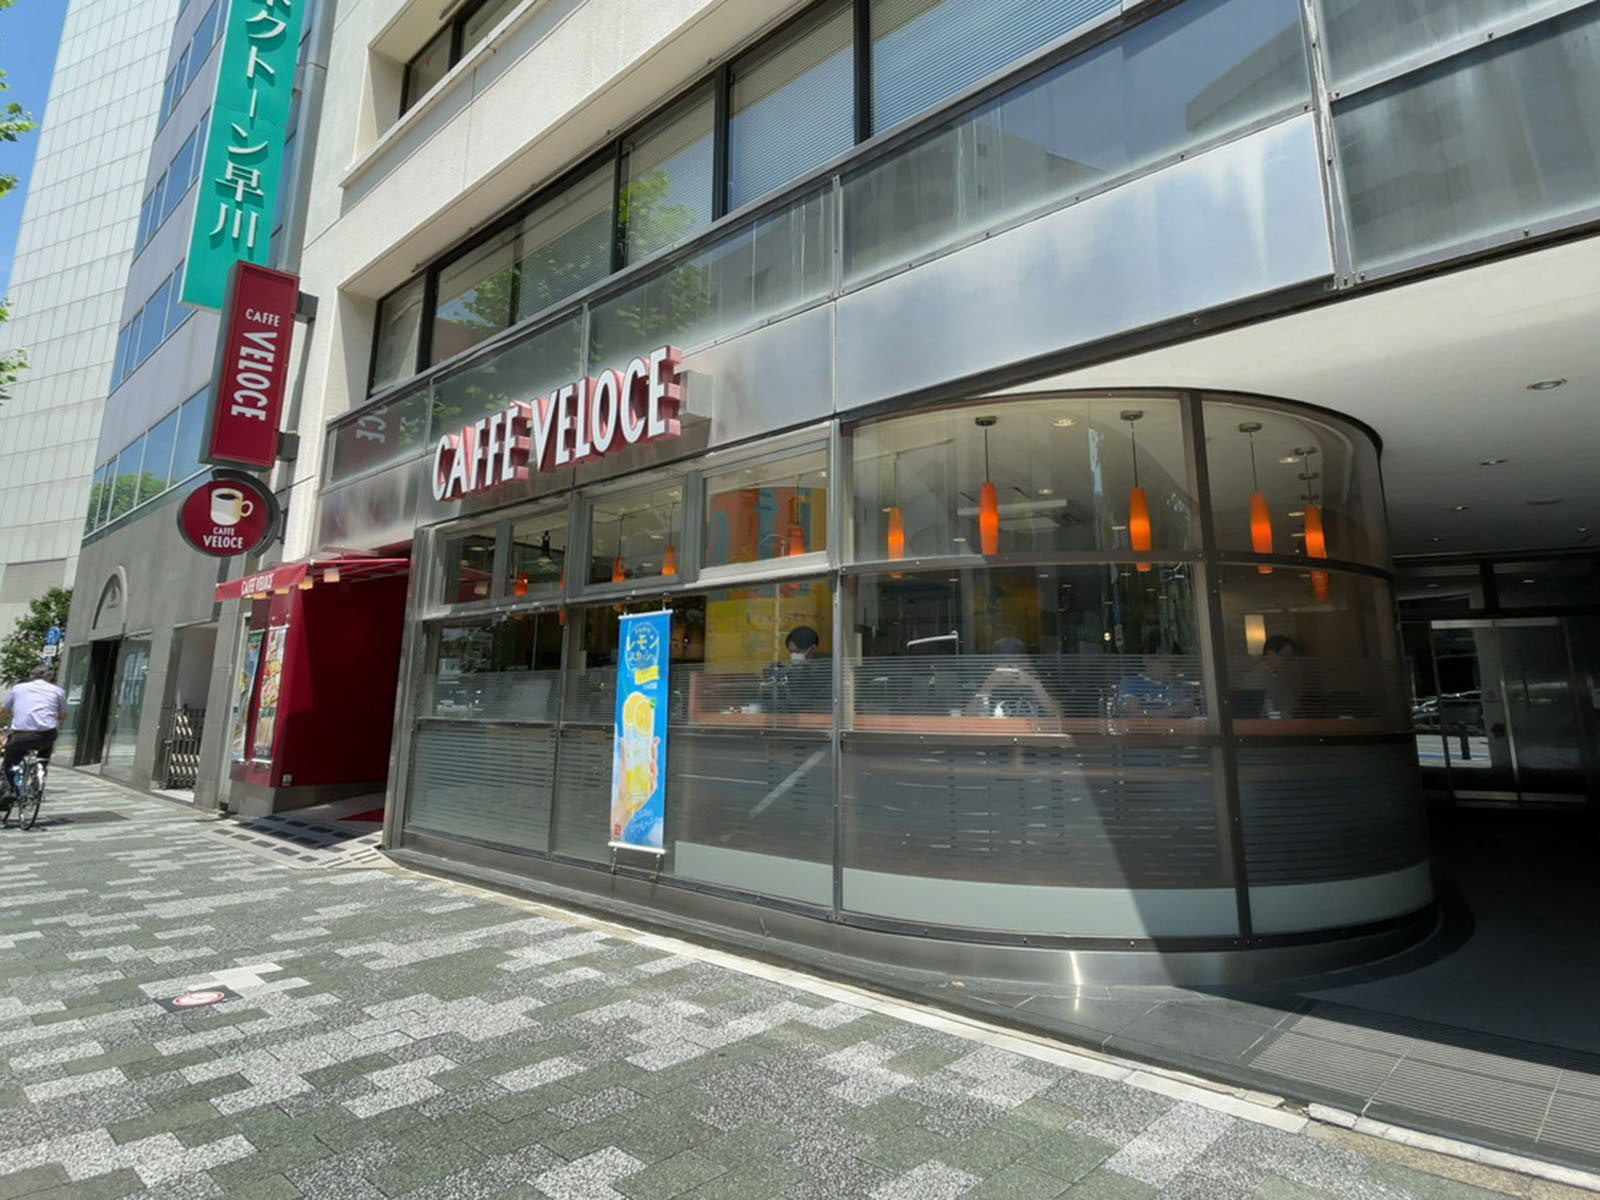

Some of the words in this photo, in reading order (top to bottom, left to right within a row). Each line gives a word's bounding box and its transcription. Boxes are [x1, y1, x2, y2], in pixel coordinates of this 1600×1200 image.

[208, 0, 291, 248] クトーン早川
[245, 308, 281, 327] CAFFE
[230, 331, 278, 421] VELOCE
[531, 345, 680, 472] VELOCE
[202, 535, 243, 549] VELOCE
